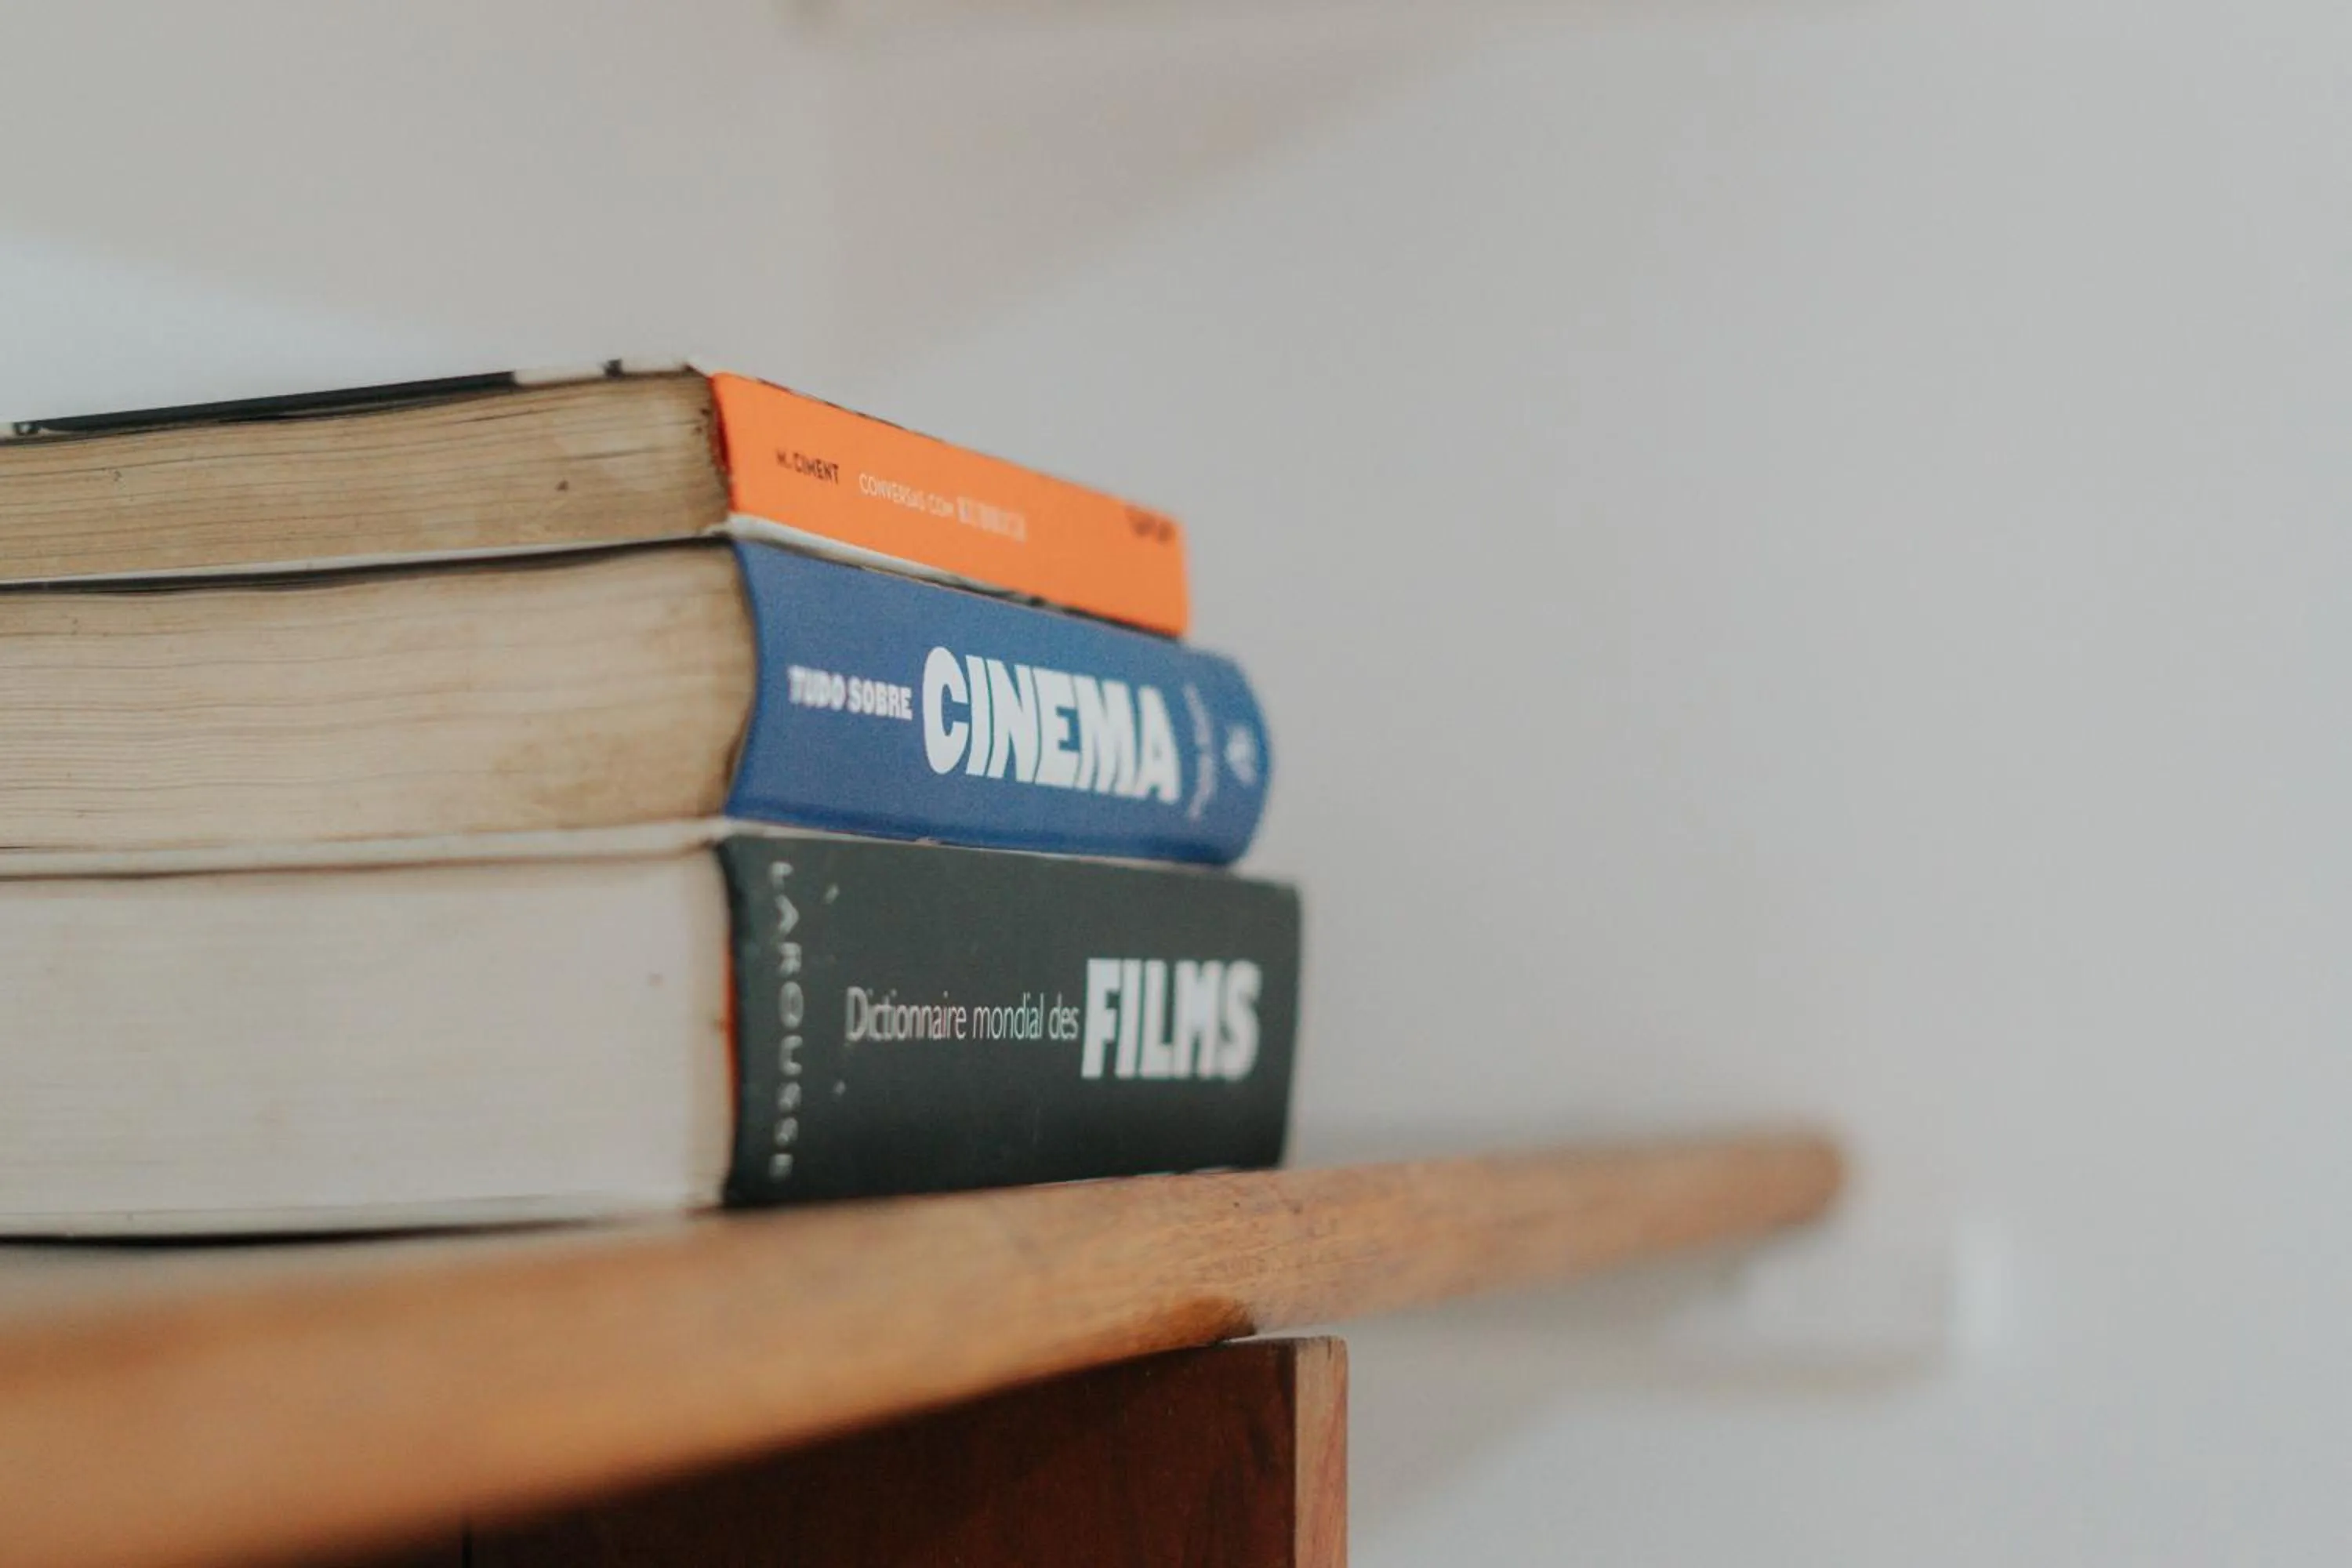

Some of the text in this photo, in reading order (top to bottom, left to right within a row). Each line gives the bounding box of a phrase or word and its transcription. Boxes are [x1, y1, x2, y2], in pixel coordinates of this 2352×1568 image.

[793, 452, 839, 485] CIMENT
[858, 473, 953, 517] CONVERSAS COM
[787, 665, 913, 720] TUDO SOBRE
[923, 646, 1182, 805] CINEMA
[846, 957, 1261, 1080] Dictionnaire mondial des FILMS
